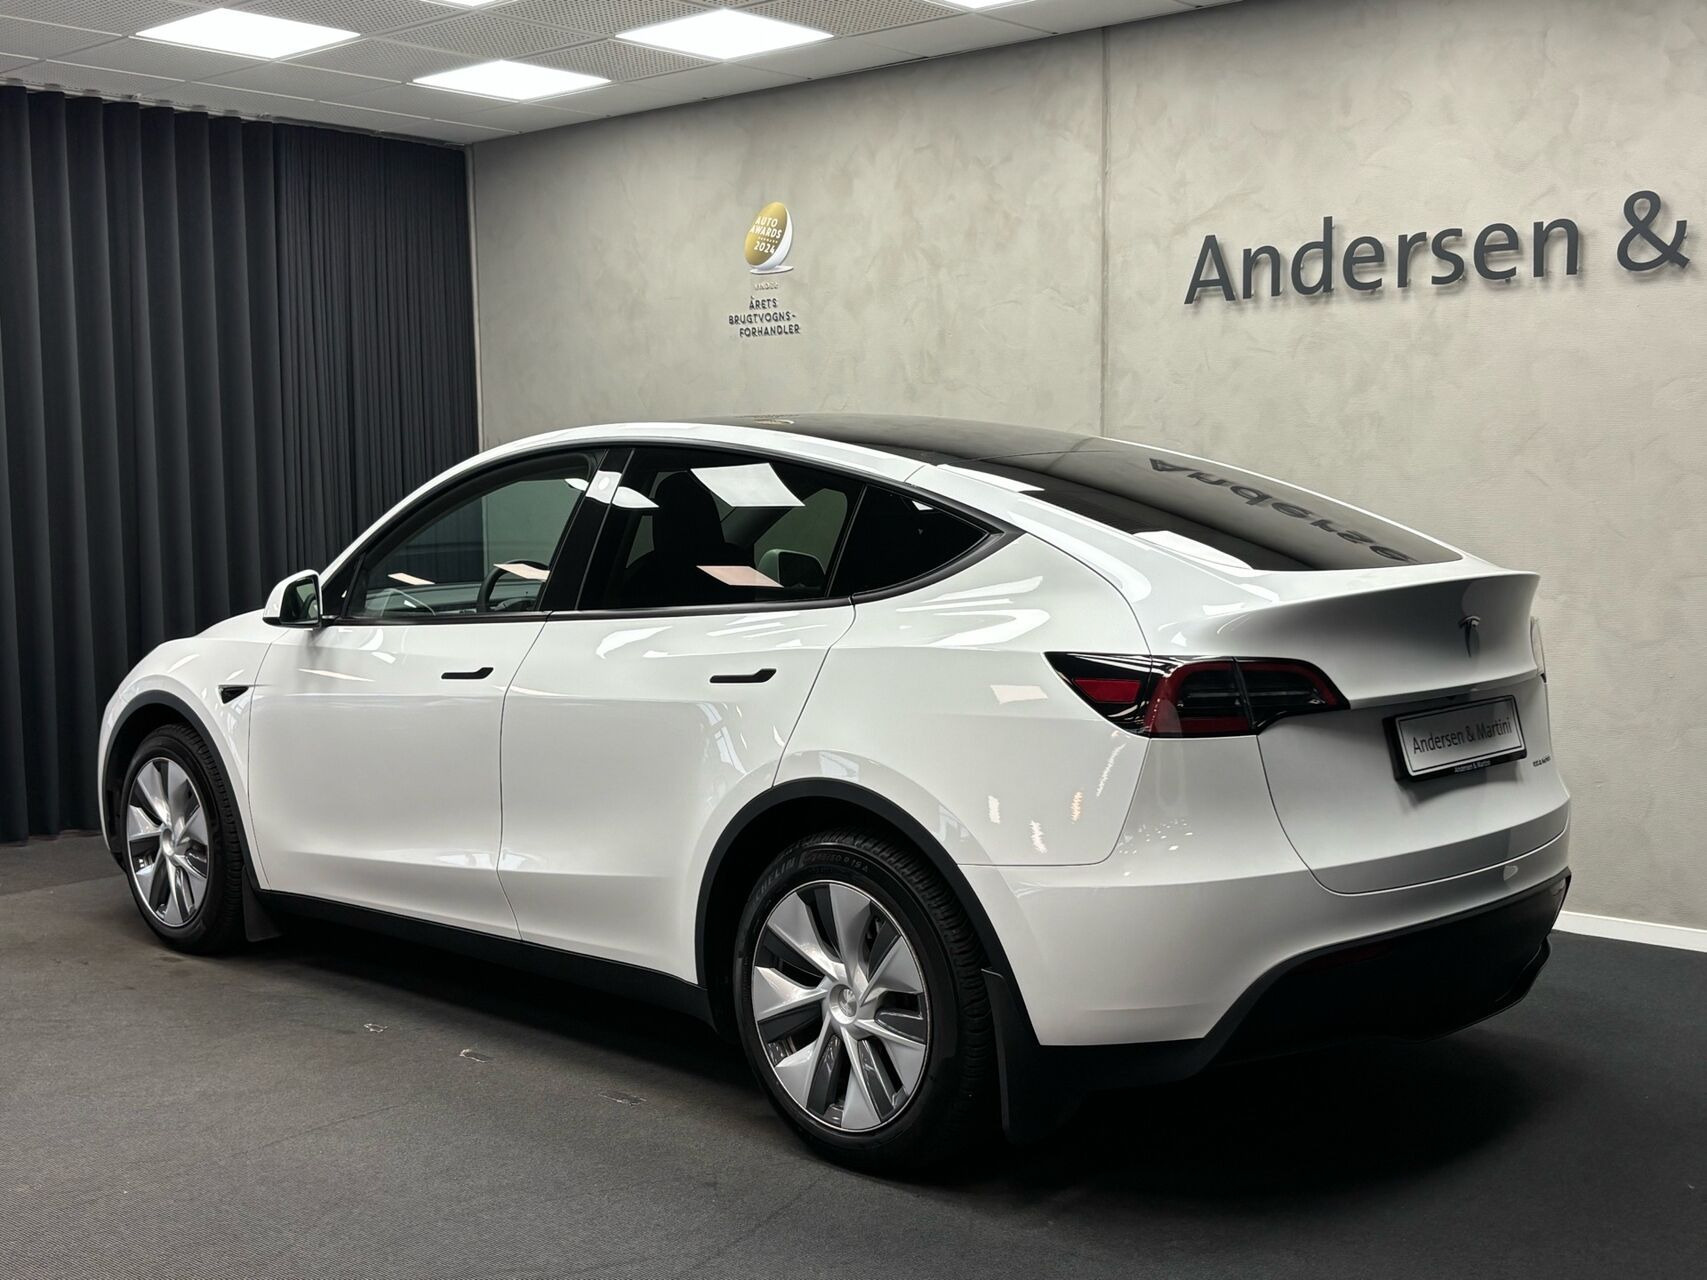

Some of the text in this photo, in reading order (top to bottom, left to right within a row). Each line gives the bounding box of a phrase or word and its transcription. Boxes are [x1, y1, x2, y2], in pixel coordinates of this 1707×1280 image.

[755, 215, 779, 229] AUTO
[749, 225, 783, 240] AWARDS
[754, 240, 777, 254] 2024
[1184, 190, 1691, 305] Andersen &
[749, 296, 777, 310] ÅRETS
[728, 311, 797, 325] BRUGTVOGNS-
[739, 323, 800, 338] FORHANDLER
[1413, 717, 1513, 754] Andersen & Martini
